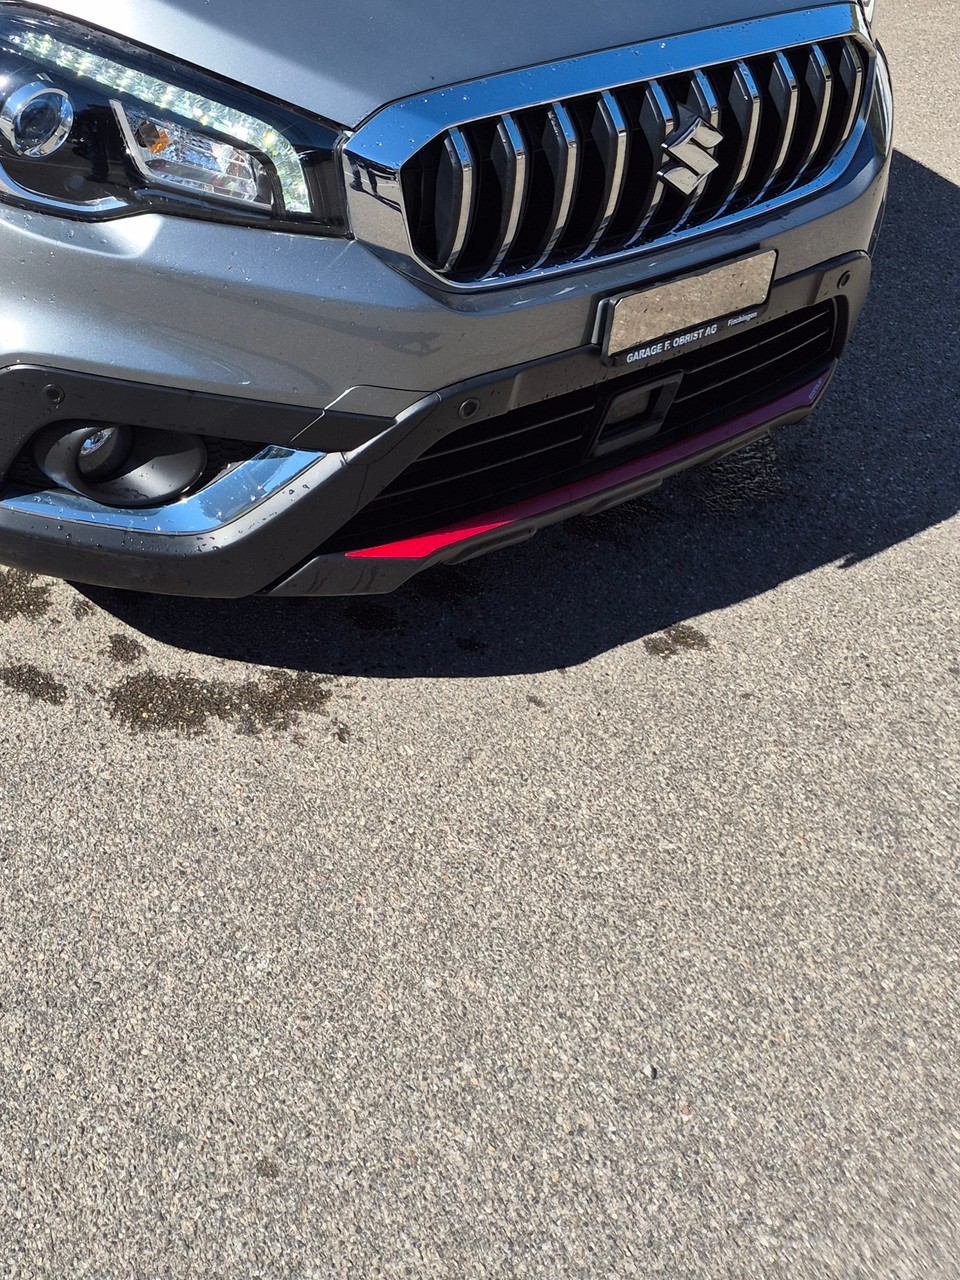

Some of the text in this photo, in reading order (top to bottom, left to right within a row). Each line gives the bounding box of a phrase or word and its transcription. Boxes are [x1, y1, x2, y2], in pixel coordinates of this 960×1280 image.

[626, 343, 663, 363] GARAGE
[664, 340, 671, 351] F.
[673, 329, 705, 347] OBRIST
[705, 324, 718, 337] AG
